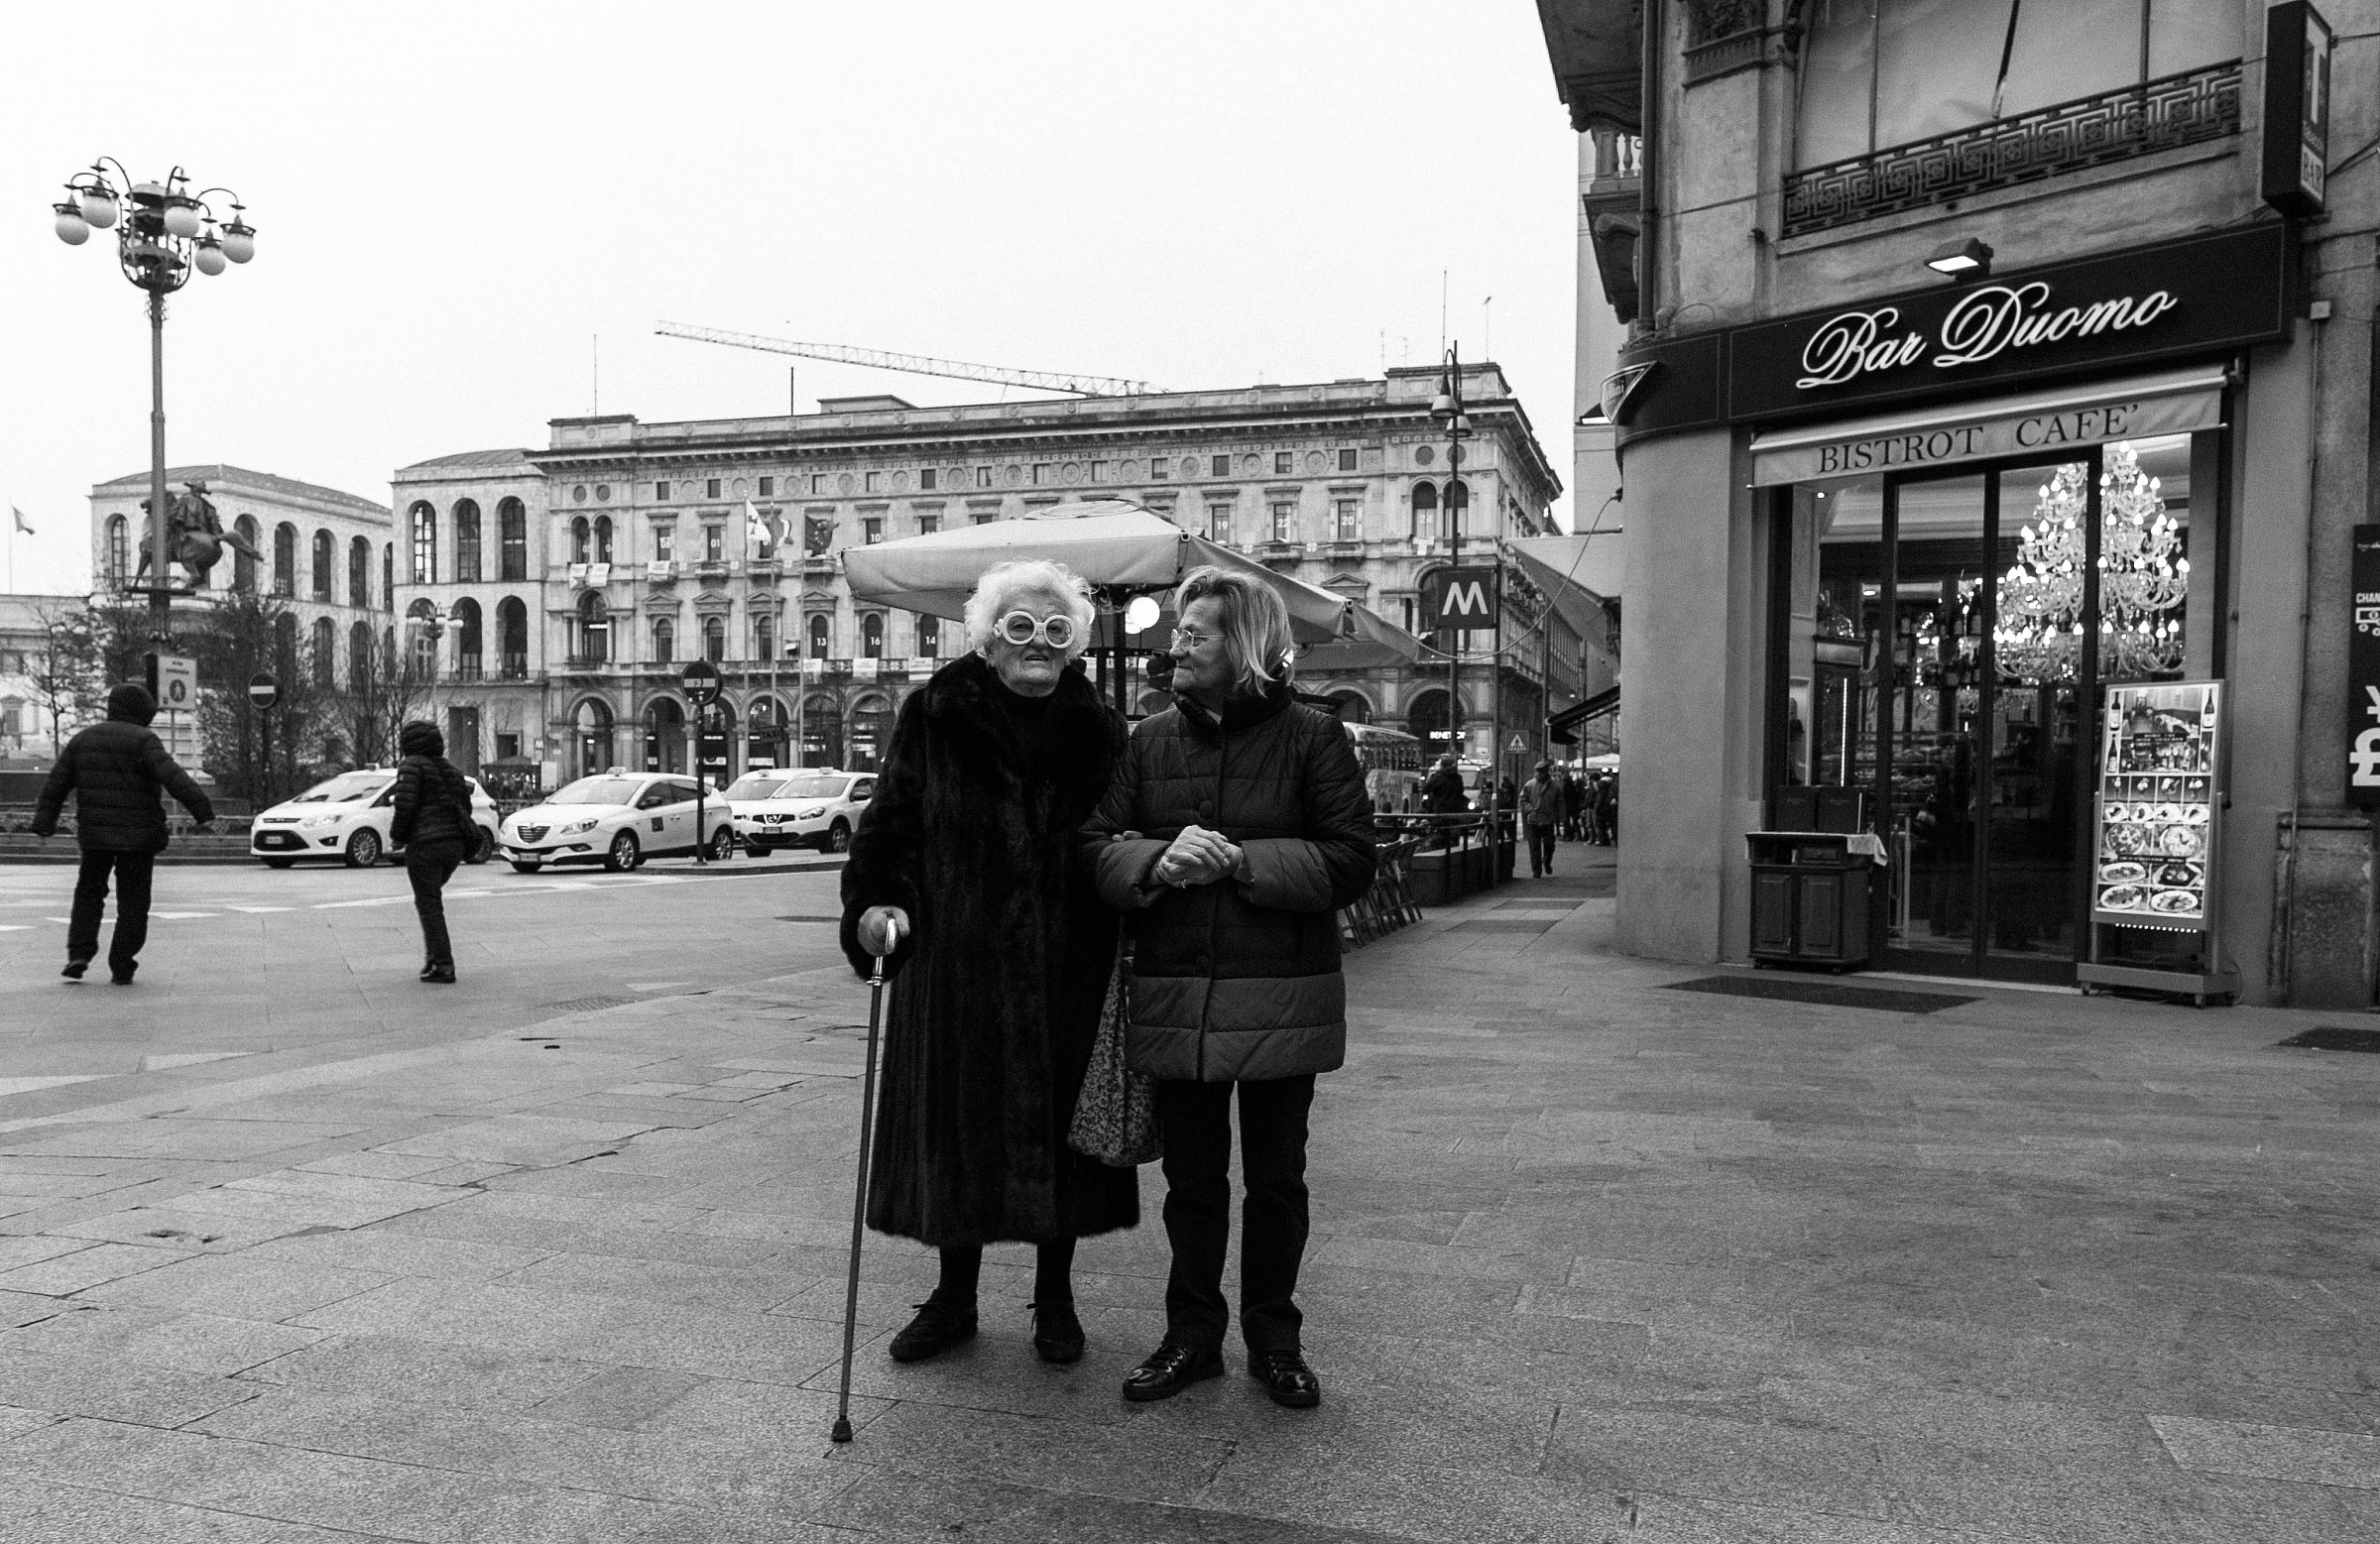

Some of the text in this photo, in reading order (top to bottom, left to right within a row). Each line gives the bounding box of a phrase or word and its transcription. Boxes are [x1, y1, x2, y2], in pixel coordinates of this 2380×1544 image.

[1796, 282, 2178, 388] Bar Duomo
[1819, 426, 1983, 474] BISTROT
[1217, 521, 1229, 531] 19
[1341, 516, 1355, 526] 20
[871, 533, 881, 542] 10
[710, 538, 721, 548] 01
[1441, 581, 1488, 615] M
[816, 638, 827, 647] 13
[871, 637, 881, 646] 16
[925, 636, 936, 645] 14
